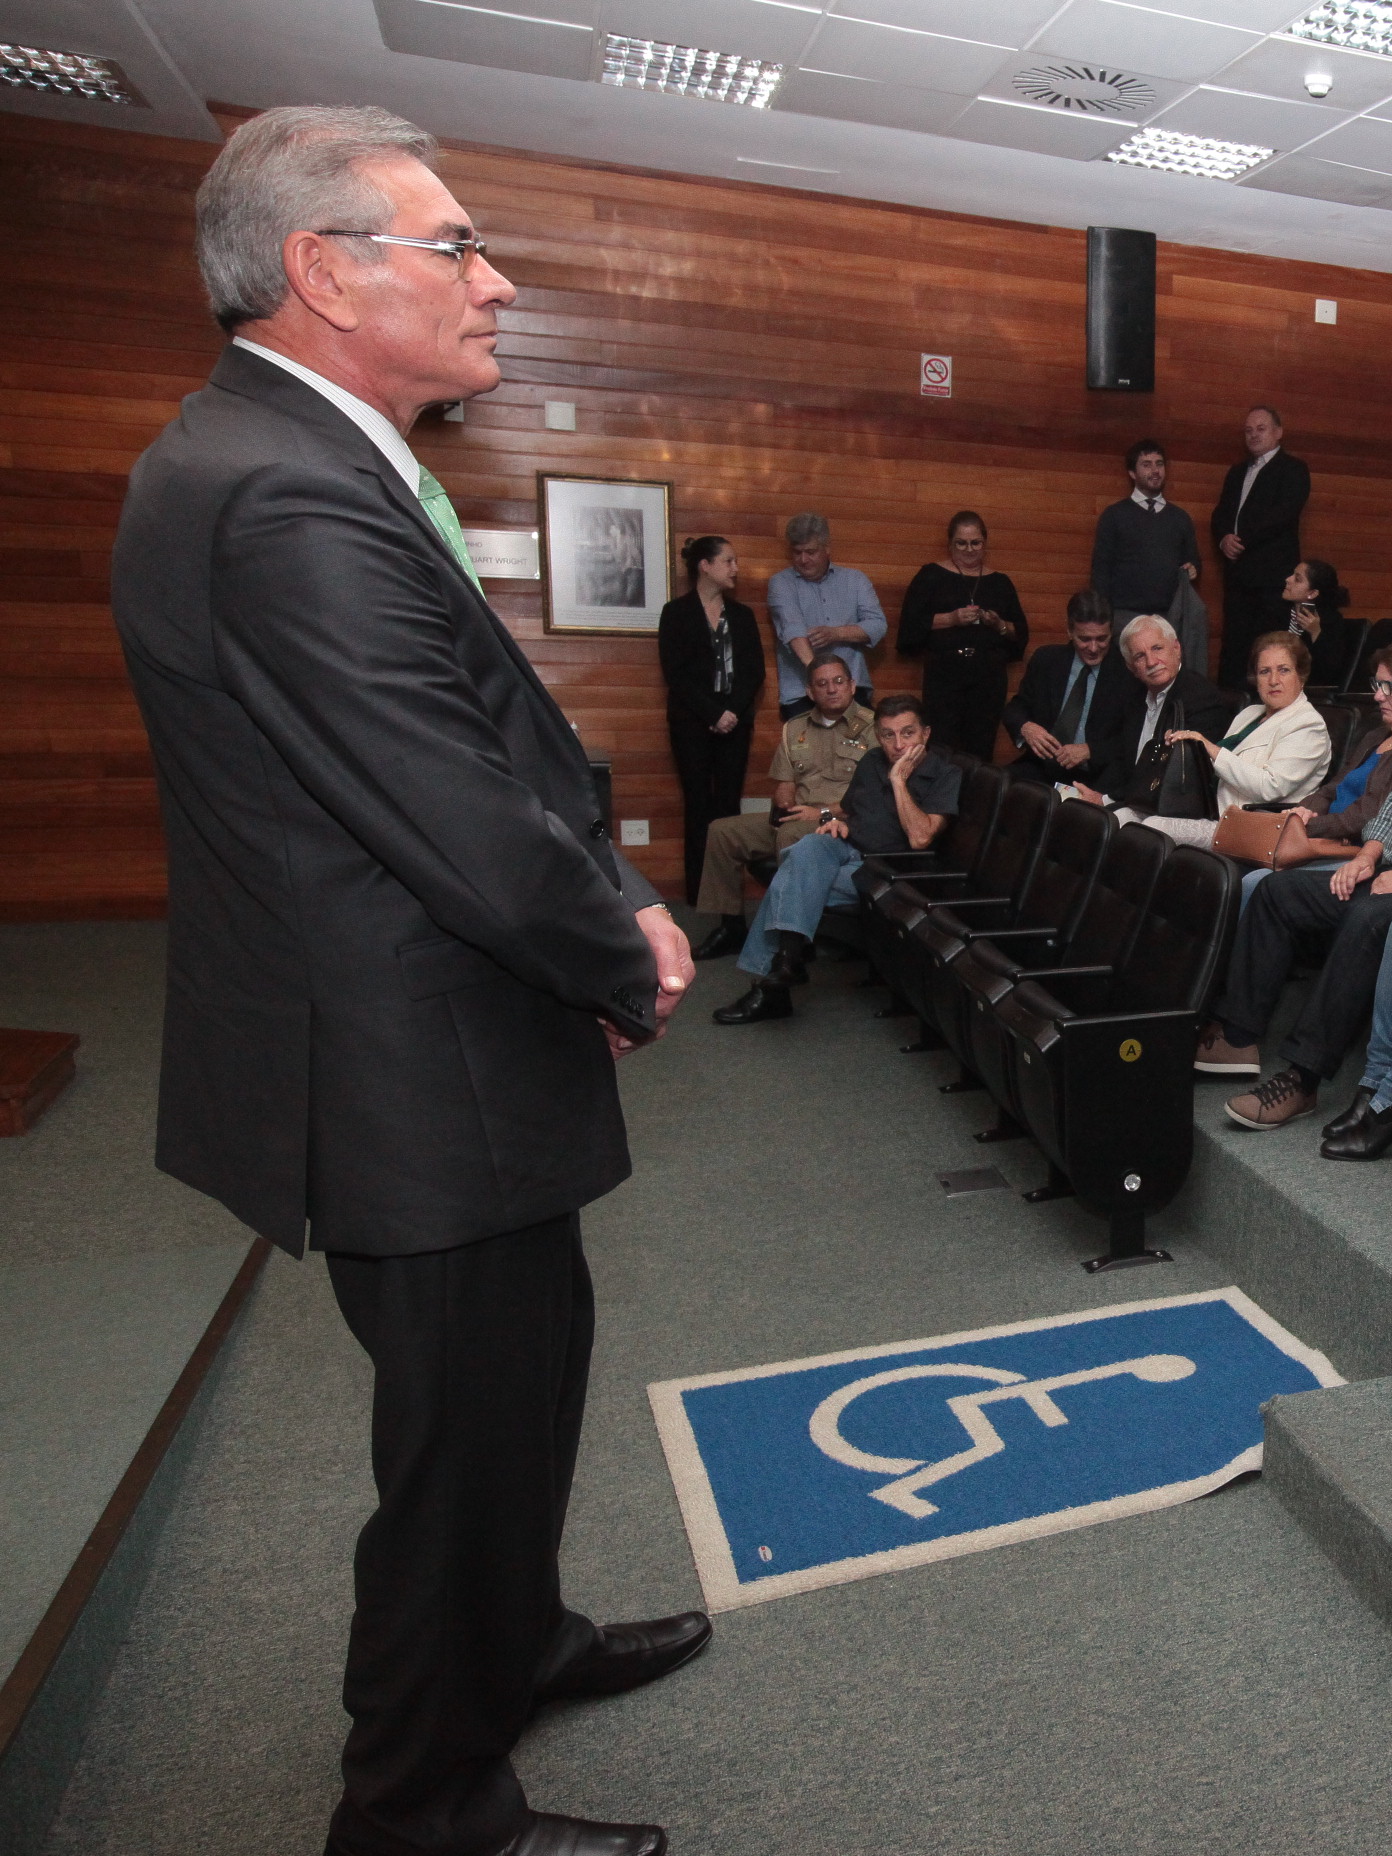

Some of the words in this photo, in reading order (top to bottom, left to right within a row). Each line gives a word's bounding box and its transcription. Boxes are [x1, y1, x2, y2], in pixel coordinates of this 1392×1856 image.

[470, 556, 493, 564] UART
[495, 557, 527, 566] WRIGHT
[1126, 1044, 1137, 1057] A
